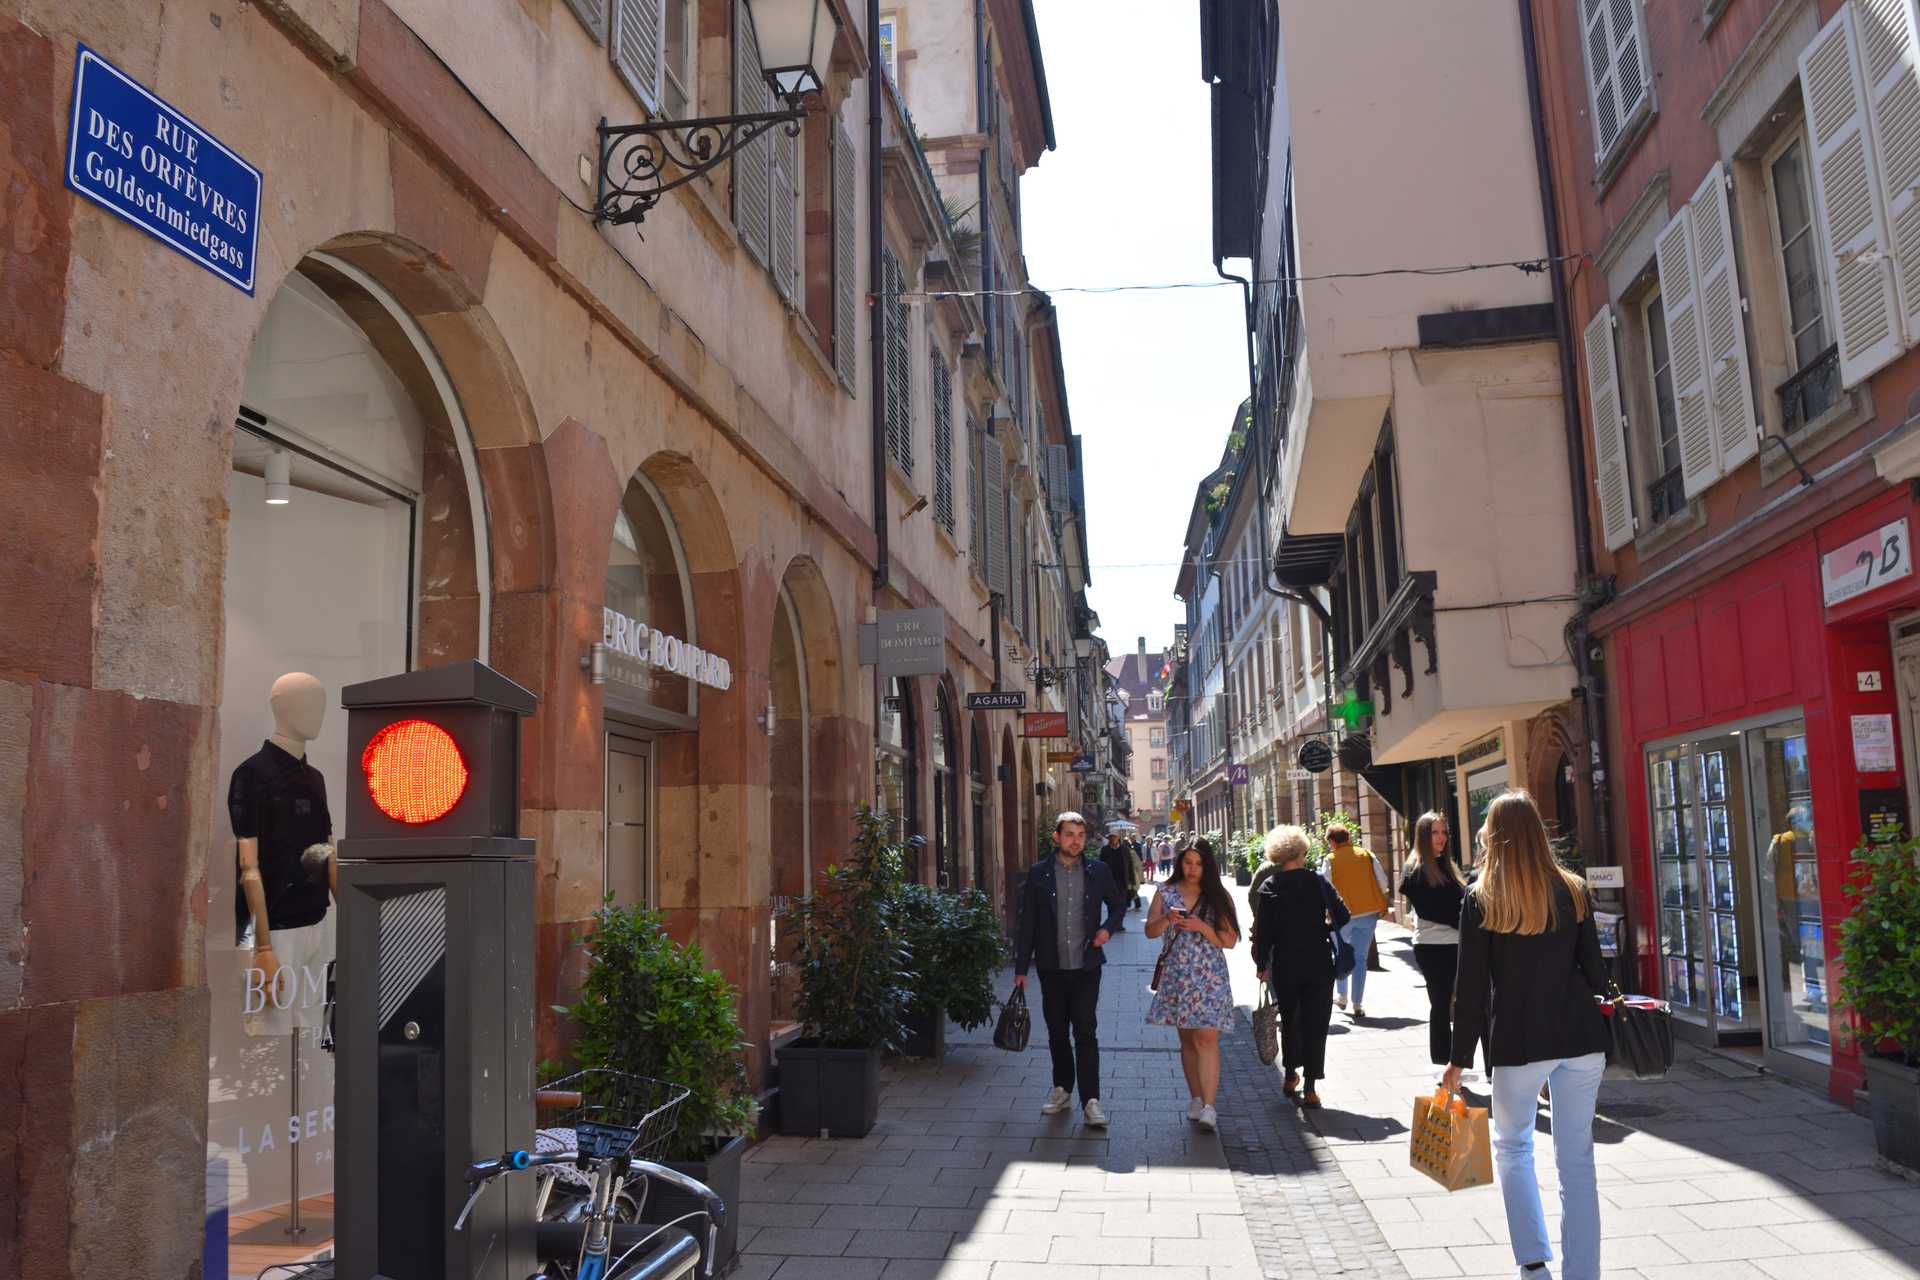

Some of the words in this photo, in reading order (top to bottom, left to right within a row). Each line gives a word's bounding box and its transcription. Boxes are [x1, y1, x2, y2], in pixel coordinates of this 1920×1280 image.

[155, 112, 199, 164] RUE
[87, 107, 134, 160] DES
[140, 144, 248, 235] ORFÈVRES
[86, 151, 244, 270] Goldschmiedgass
[603, 606, 649, 661] ERIC
[650, 628, 732, 690] BOMPARD
[880, 636, 943, 649] BOMPARD
[974, 695, 1019, 706] AGATHA
[1864, 674, 1875, 688] 4
[242, 963, 336, 1015] BOM
[239, 1123, 275, 1154] LA
